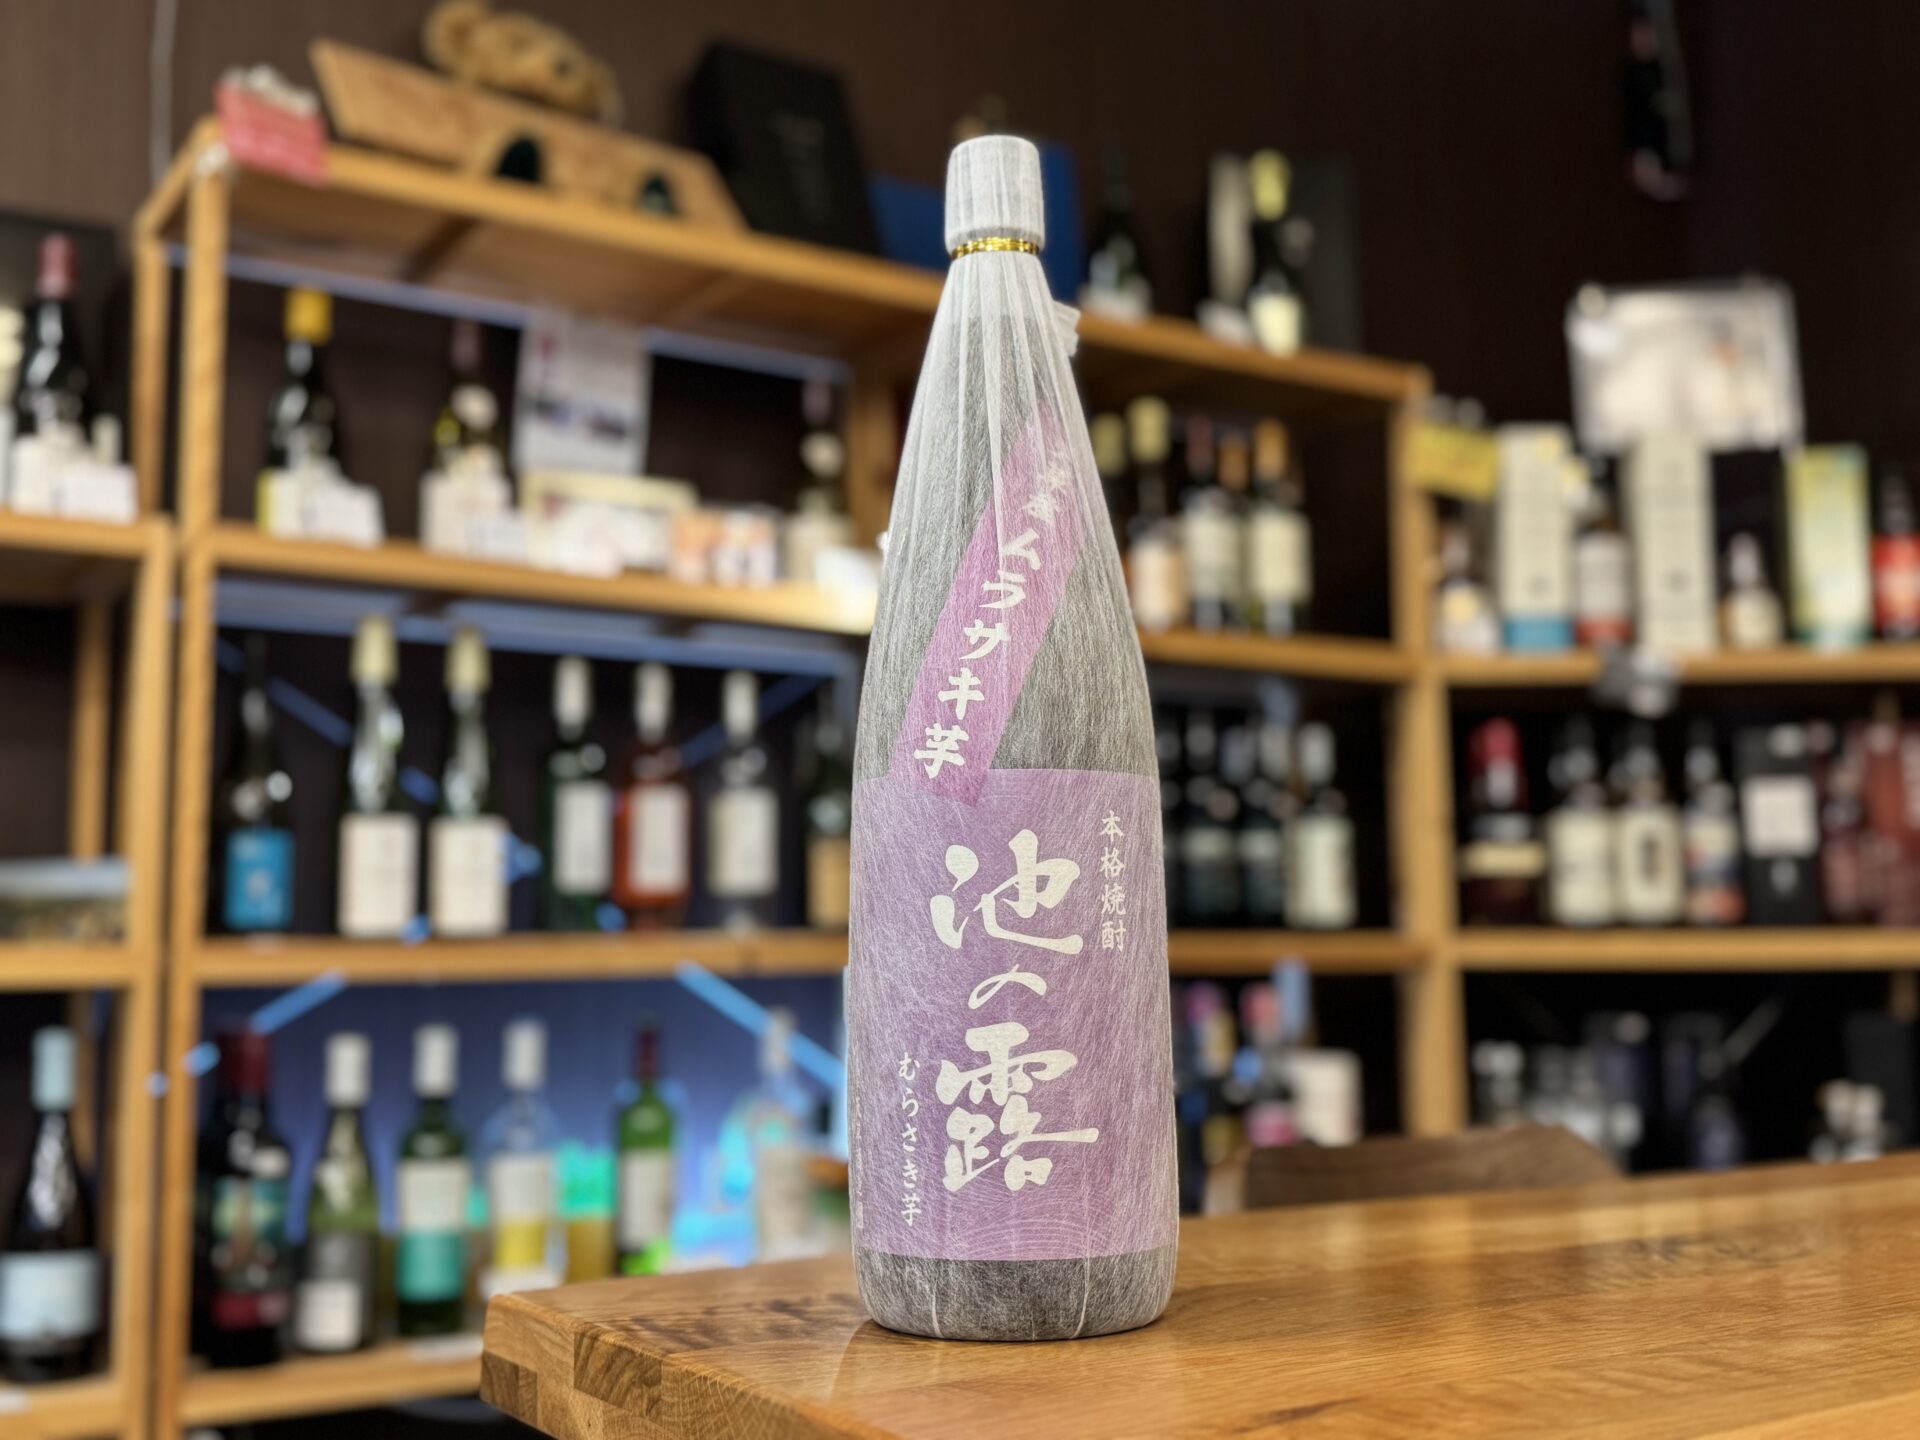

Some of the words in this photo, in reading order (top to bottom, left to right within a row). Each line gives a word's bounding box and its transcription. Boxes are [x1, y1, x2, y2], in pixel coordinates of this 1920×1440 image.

[1100, 809, 1127, 953] 本格焼酎
[930, 828, 1099, 1193] 池の露
[898, 1051, 923, 1228] むらさき芋
